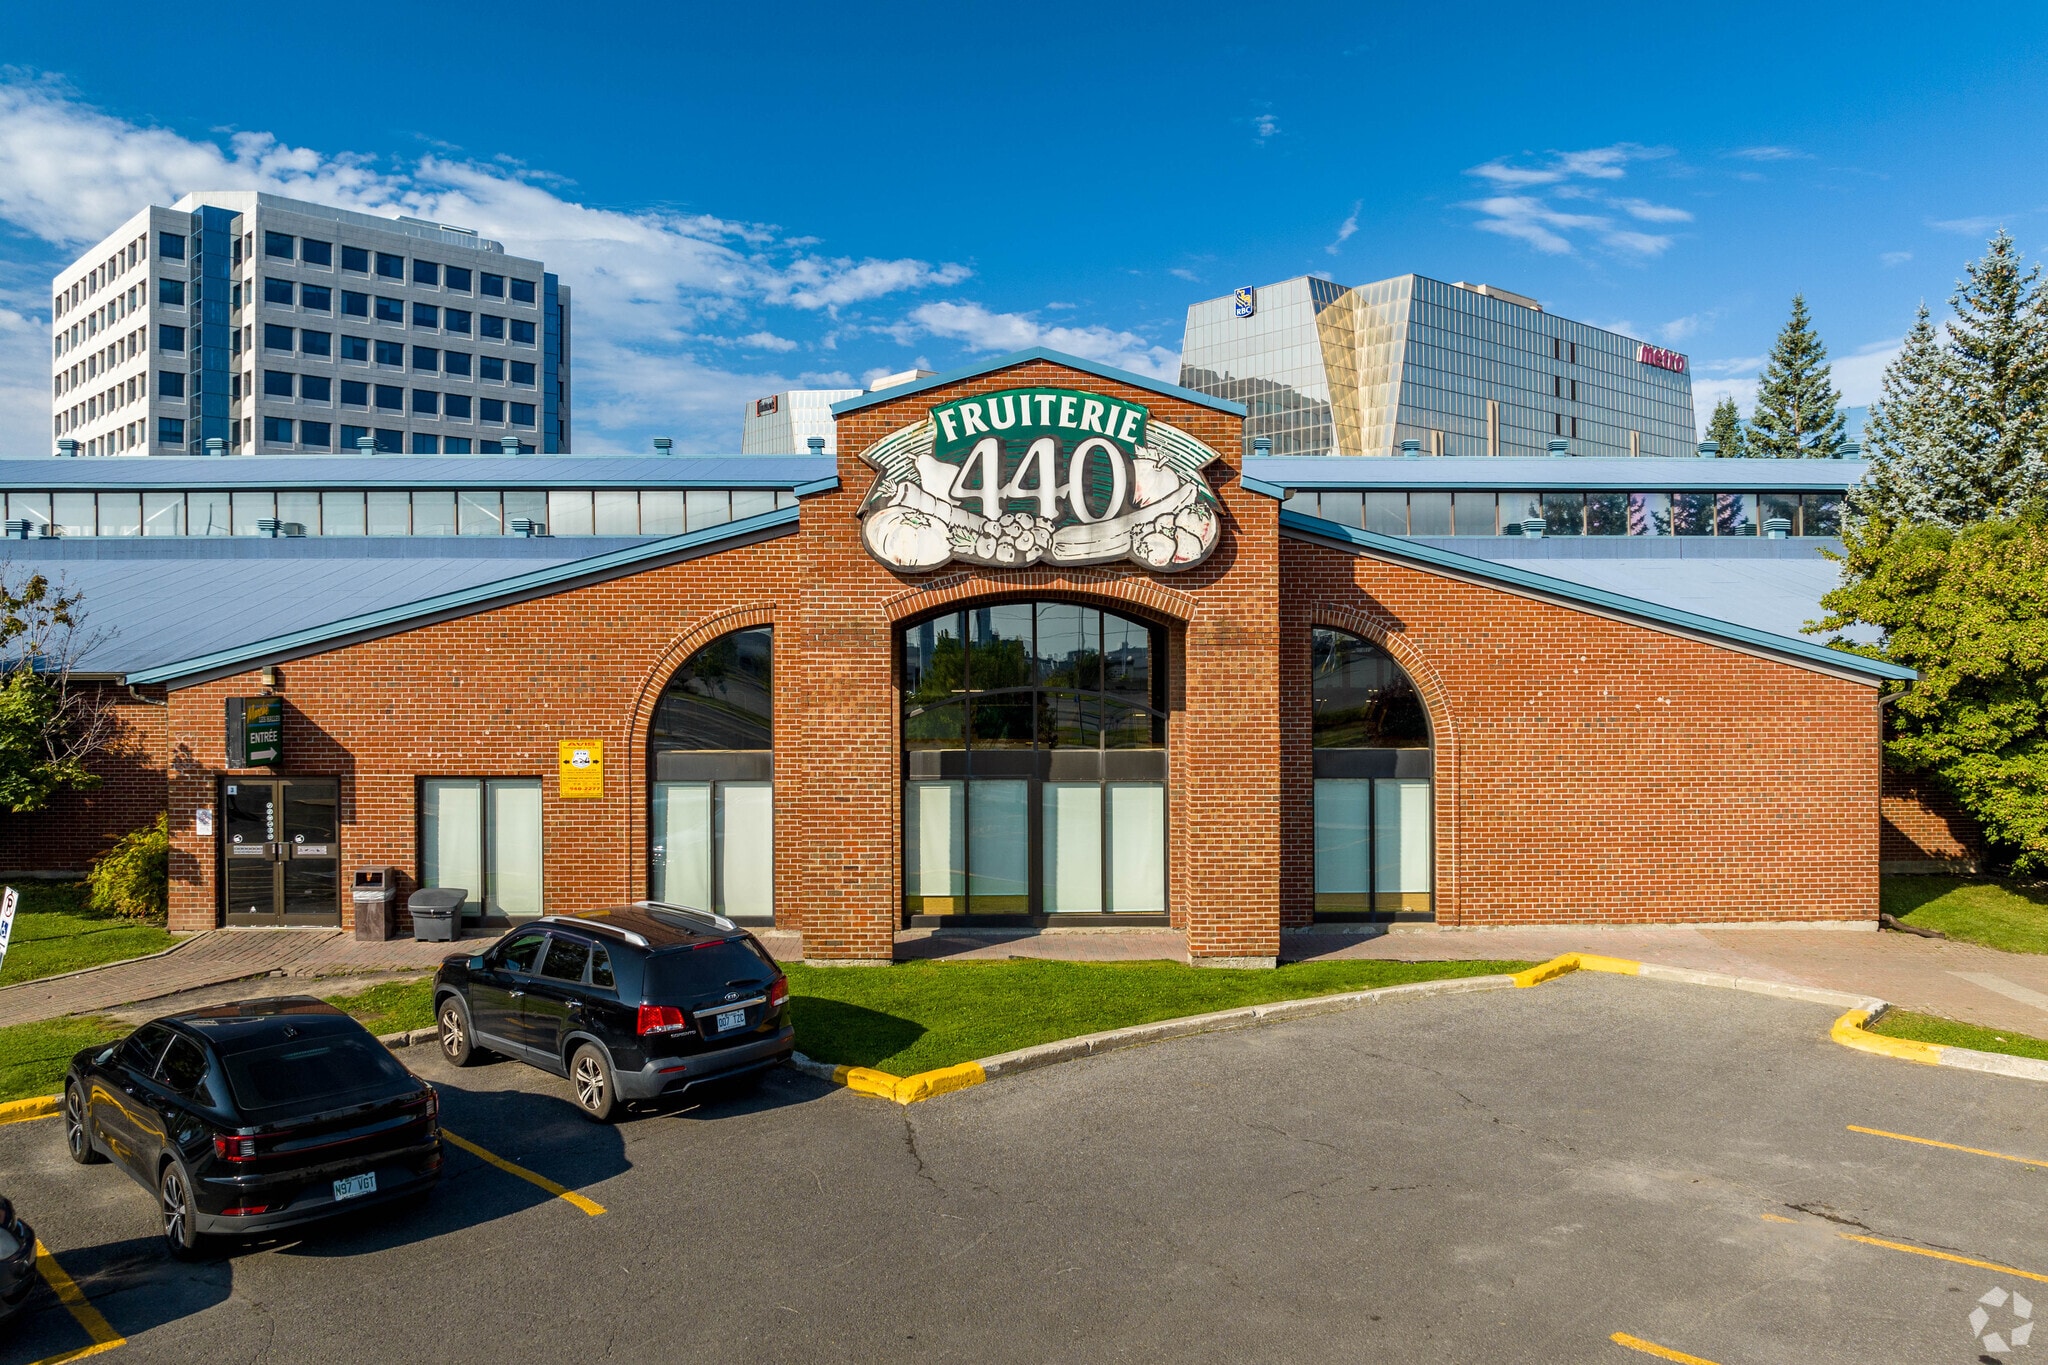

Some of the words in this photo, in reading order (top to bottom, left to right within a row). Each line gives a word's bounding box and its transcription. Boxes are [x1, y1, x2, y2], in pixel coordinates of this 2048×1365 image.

[1236, 306, 1251, 316] RBC
[1637, 344, 1685, 373] metro
[937, 394, 1143, 443] FRUITERIE
[951, 437, 1127, 524] 440
[250, 729, 278, 744] ENTRÉE
[335, 1181, 352, 1196] N97
[357, 1175, 374, 1190] VGT
